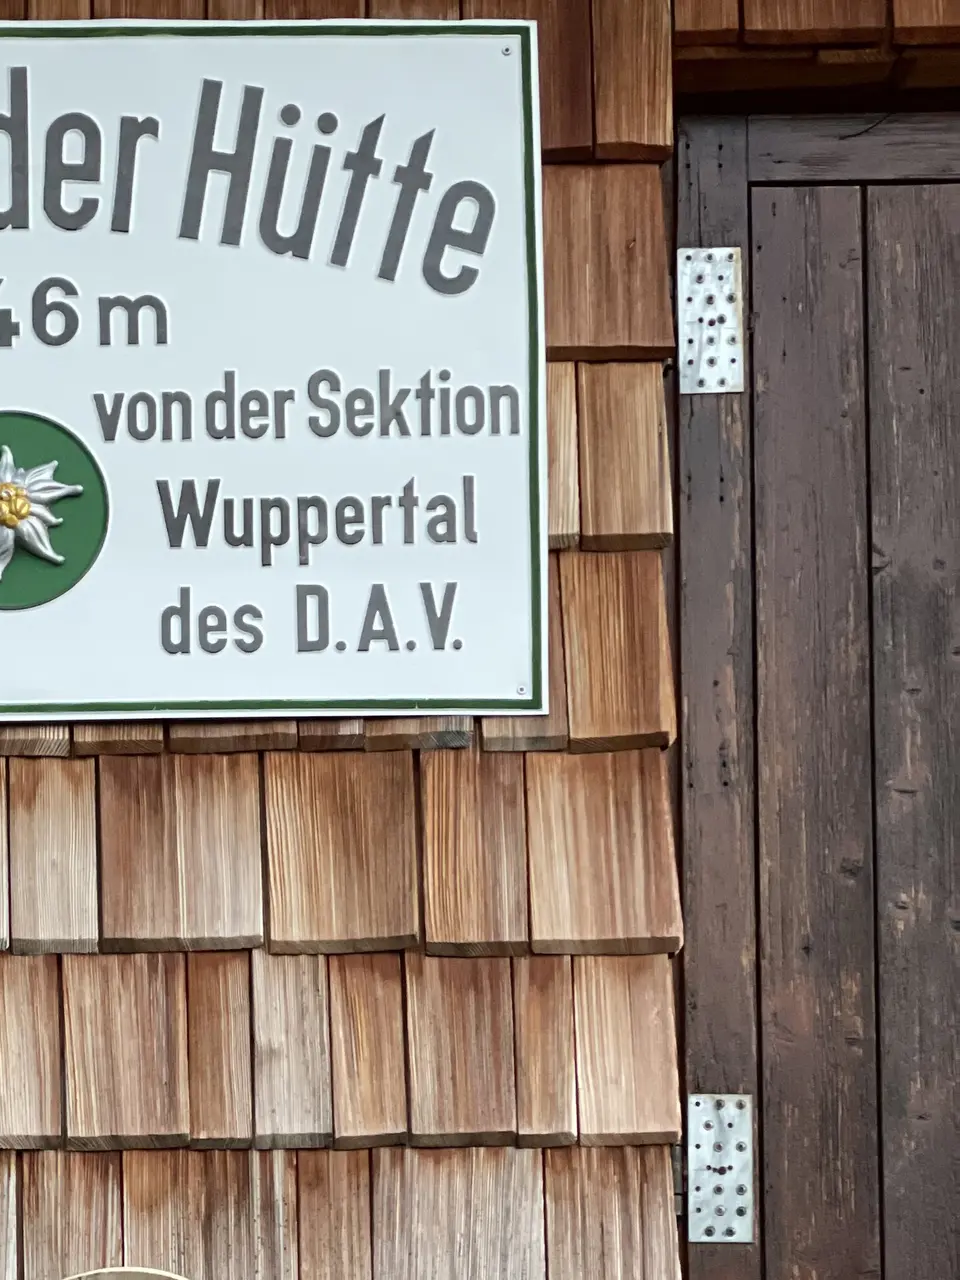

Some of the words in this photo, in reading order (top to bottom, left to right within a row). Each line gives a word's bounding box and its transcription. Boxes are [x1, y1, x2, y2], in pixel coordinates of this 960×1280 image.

[178, 78, 496, 295] Hütte
[98, 294, 169, 347] m
[93, 392, 192, 443] von
[205, 370, 296, 441] der
[307, 368, 521, 439] Sektion
[155, 475, 479, 569] Wuppertal
[161, 585, 265, 656] des
[295, 581, 464, 654] D.A.V.
